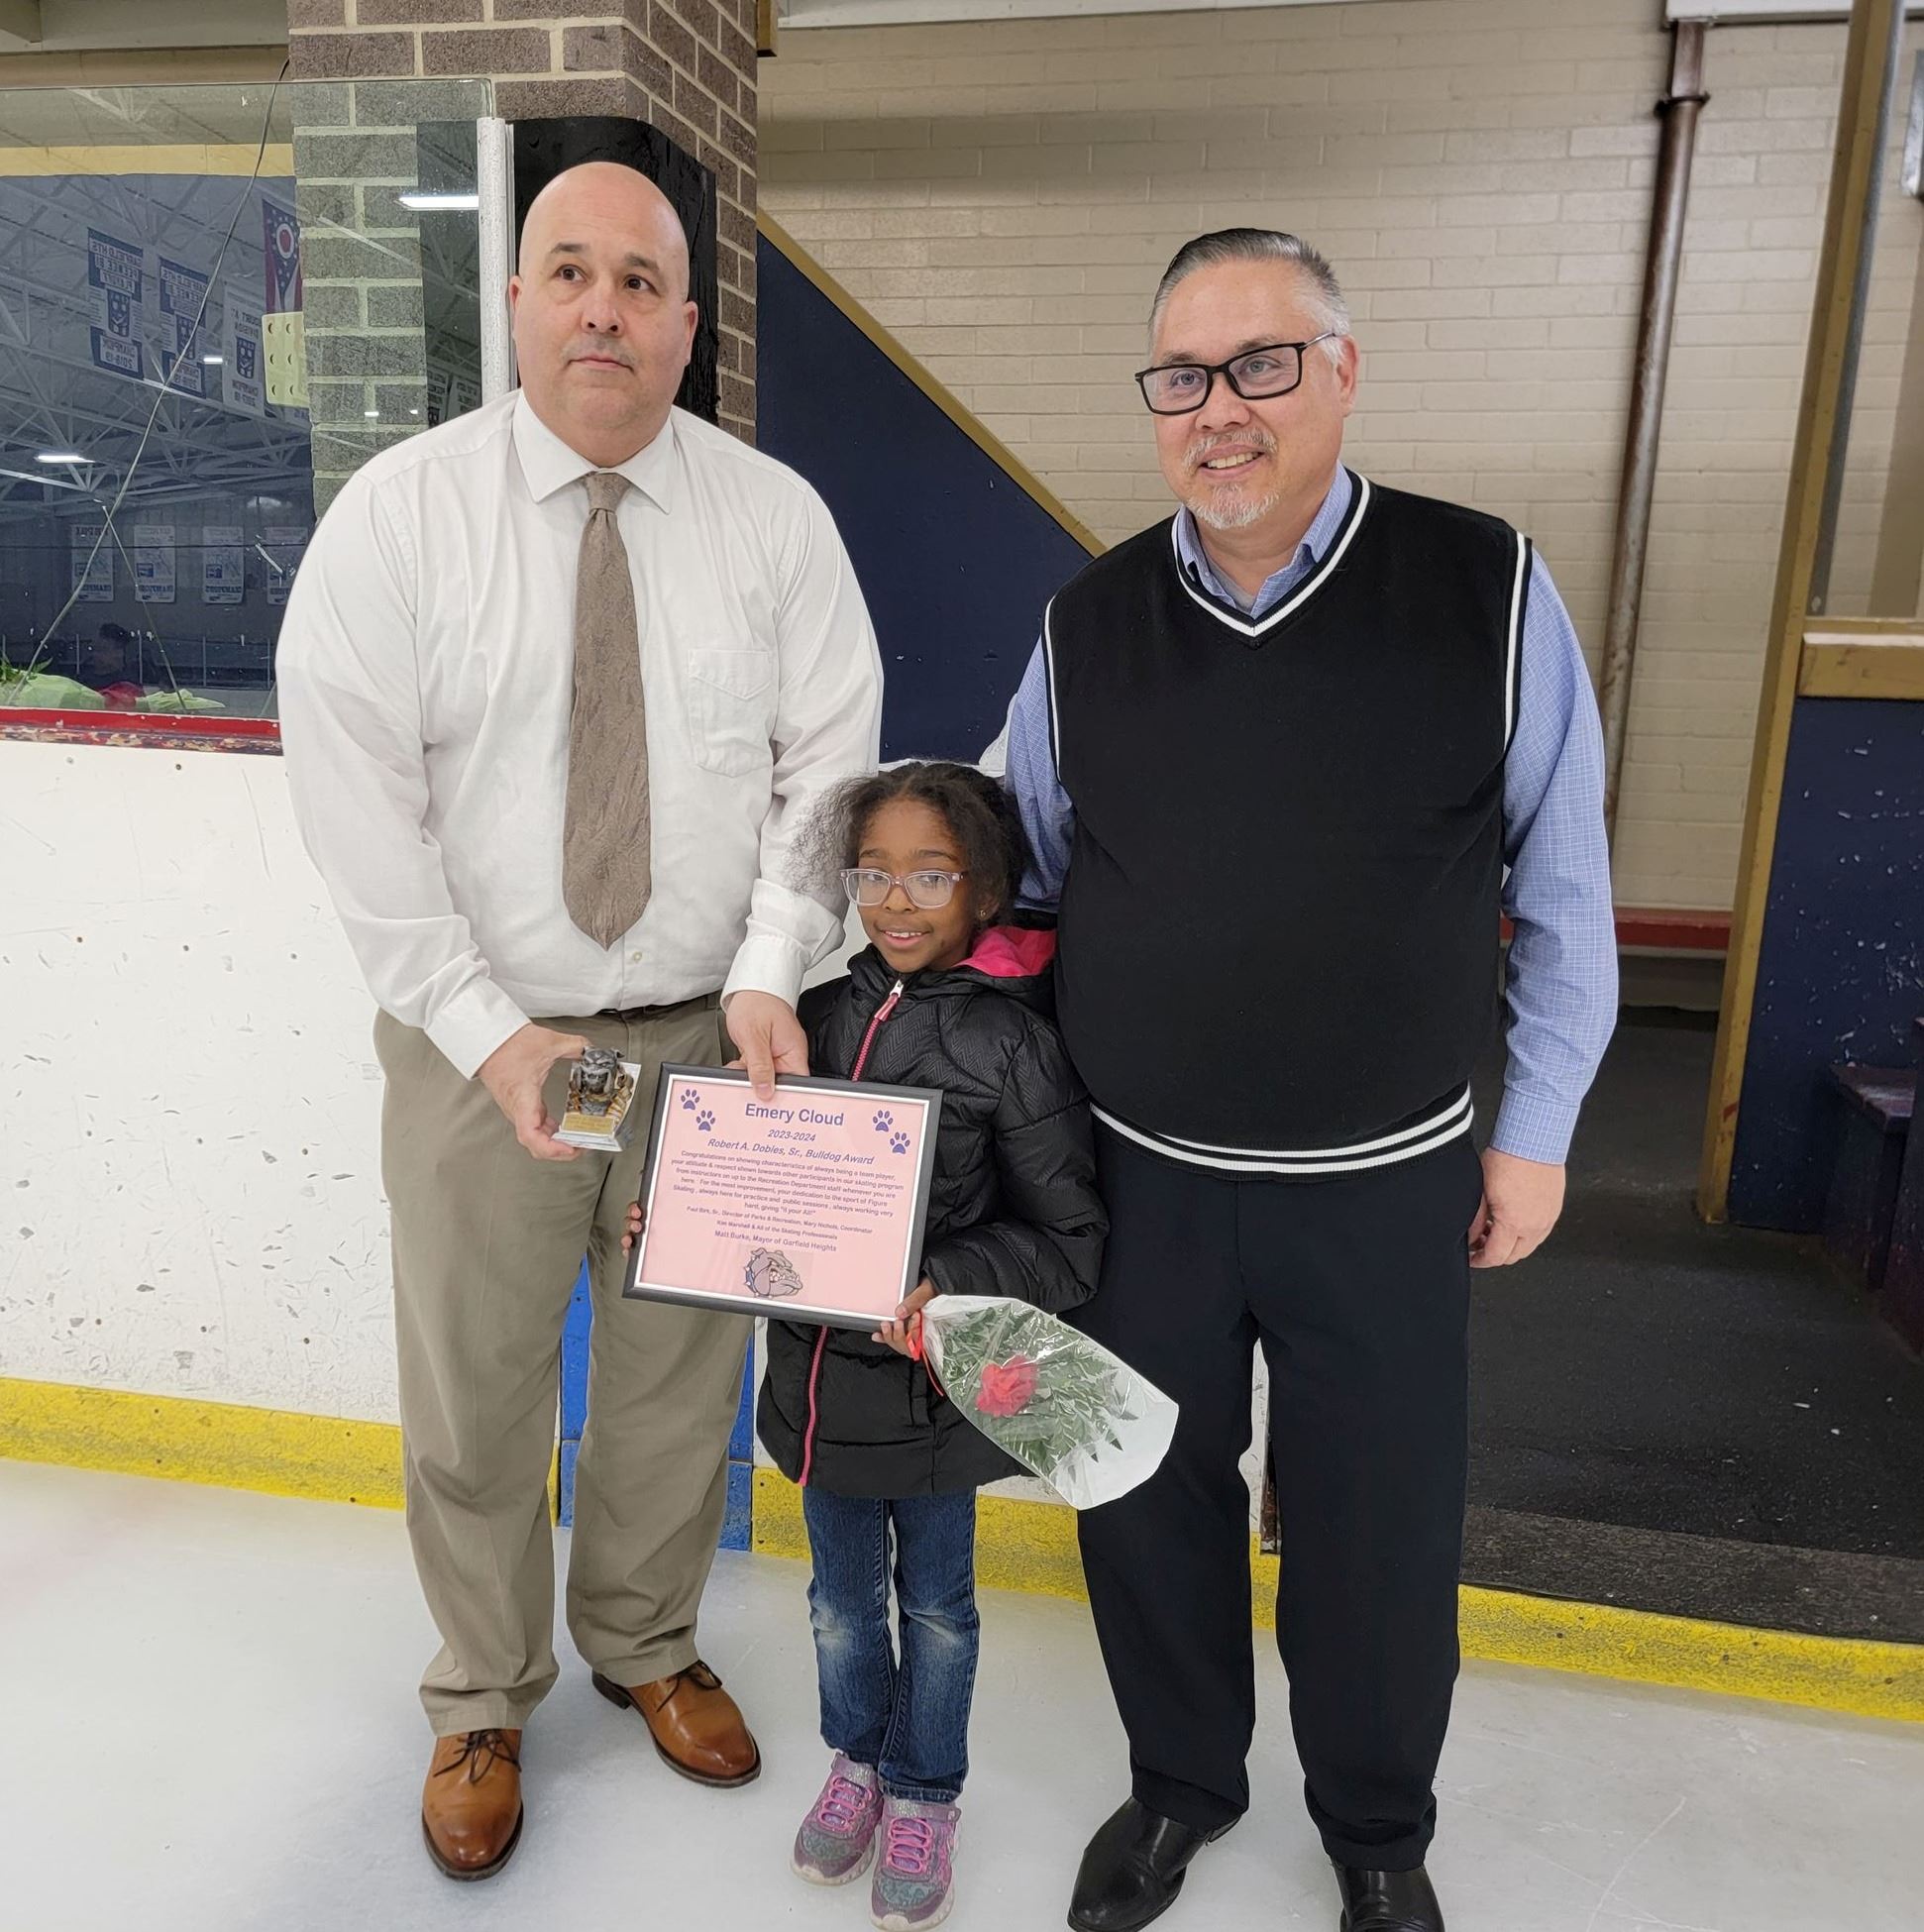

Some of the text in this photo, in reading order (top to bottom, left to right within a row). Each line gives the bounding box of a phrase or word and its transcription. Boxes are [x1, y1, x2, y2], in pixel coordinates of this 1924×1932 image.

[745, 1103, 844, 1126] Emery Cloud
[767, 1129, 816, 1142] 2023-2024
[707, 1138, 740, 1150] Robert
[740, 1142, 749, 1151] A.
[805, 1149, 842, 1163] Bulldog
[842, 1153, 875, 1165] Award
[681, 1150, 726, 1161] Congratulations
[736, 1157, 760, 1166] showing
[761, 1160, 805, 1170] characteristics
[836, 1168, 853, 1177] being
[875, 1173, 896, 1181] player,
[758, 1177, 790, 1185] Recreation
[790, 1180, 826, 1190] Department
[799, 1174, 835, 1182] participants
[855, 1180, 877, 1188] skating
[737, 1185, 776, 1194] improvement,
[792, 1190, 824, 1198] dedication
[761, 1205, 779, 1213] giving
[833, 1204, 853, 1213] always
[854, 1208, 879, 1216] working
[772, 1216, 802, 1225] Recreation,
[840, 1225, 873, 1234] Coordinator
[781, 1228, 801, 1236] Skating
[752, 1235, 773, 1244] Mayor
[783, 1239, 810, 1248] Garfield
[811, 1243, 837, 1252] Heights
